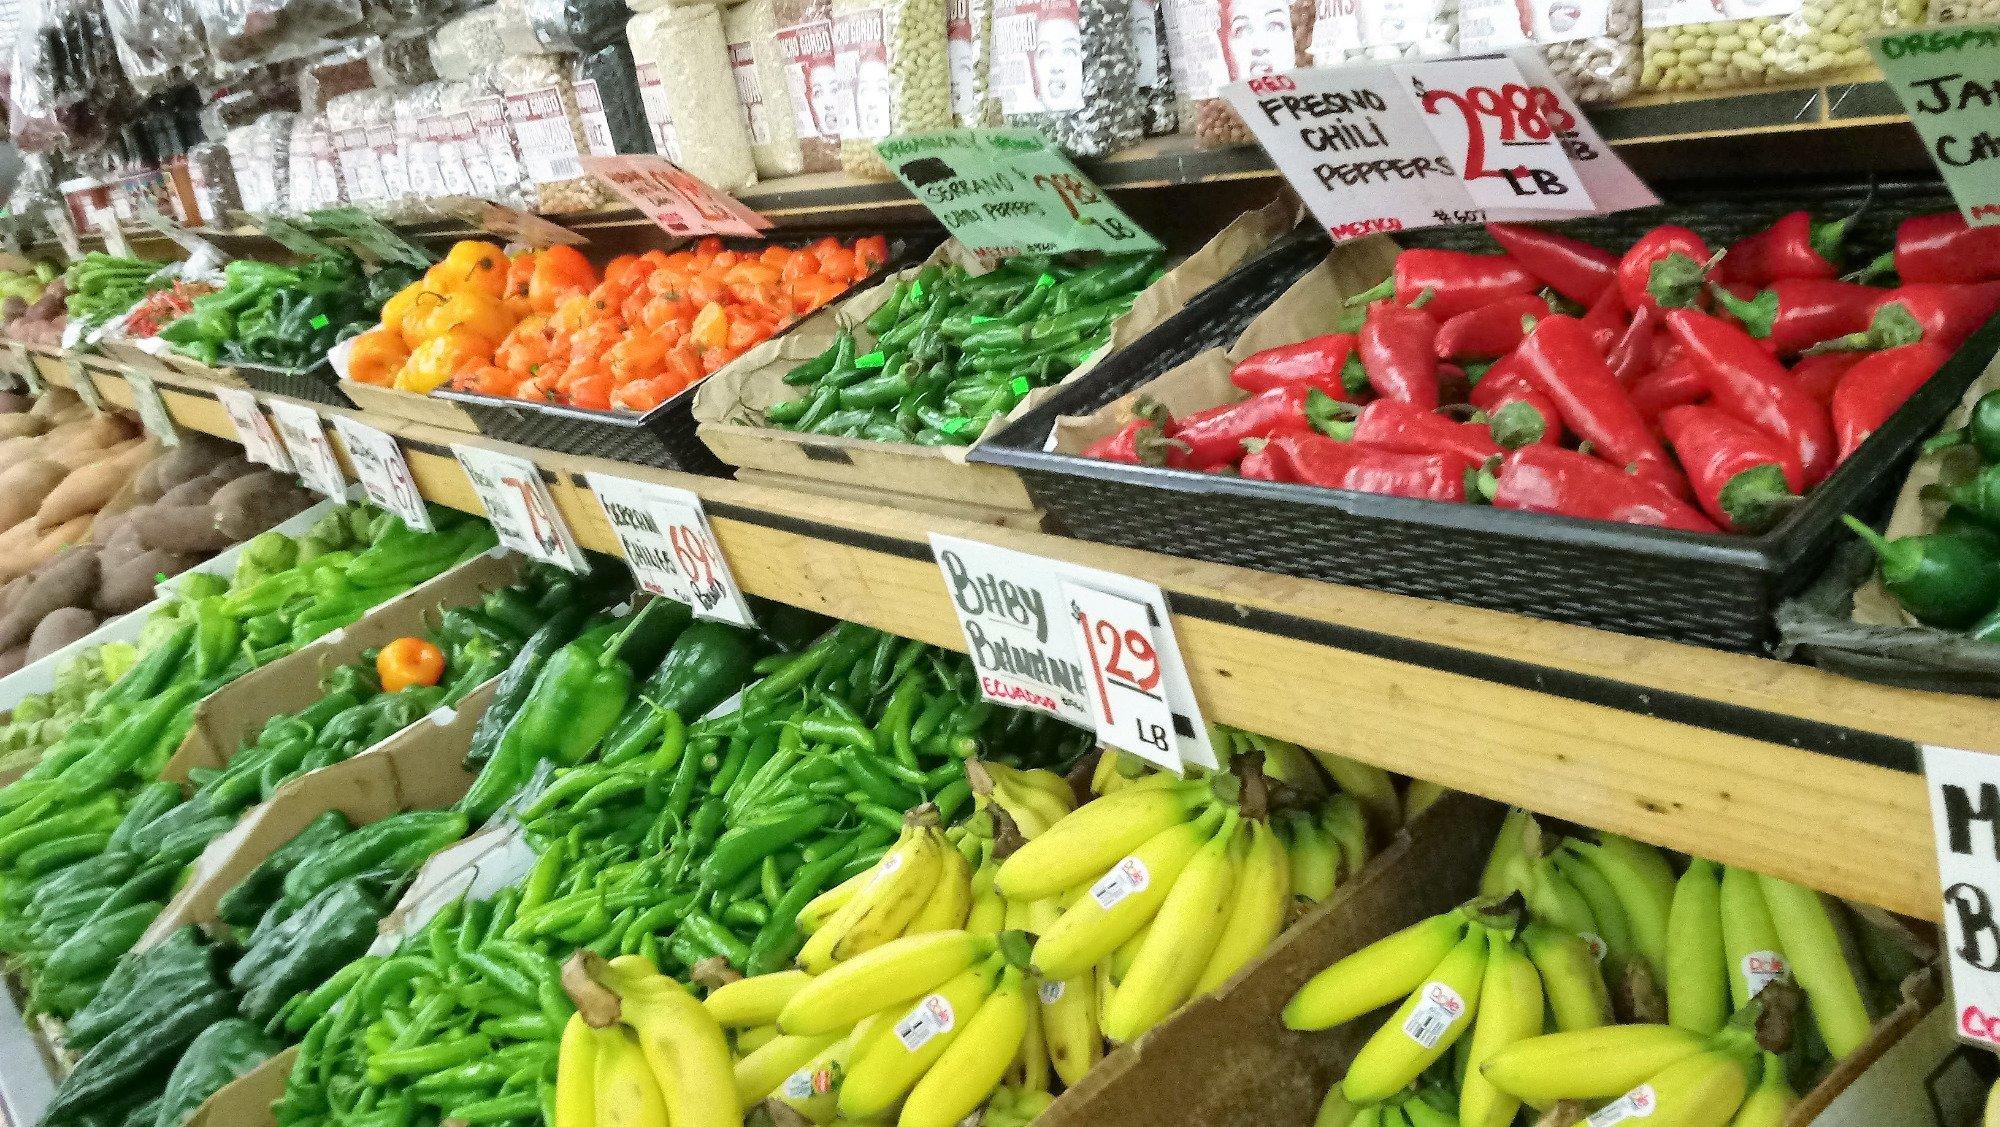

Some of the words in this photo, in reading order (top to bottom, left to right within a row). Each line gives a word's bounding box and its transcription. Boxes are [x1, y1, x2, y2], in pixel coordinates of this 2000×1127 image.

[1248, 75, 1297, 94] RED
[1258, 89, 1388, 126] FRESNO
[1300, 116, 1390, 152] CHILI
[926, 171, 1015, 204] SERRANO
[1313, 155, 1456, 192] PEPPERS
[1500, 168, 1570, 196] LB
[1330, 217, 1404, 241] MEXICO
[941, 549, 1049, 643] BABY
[1136, 717, 1170, 752] LB
